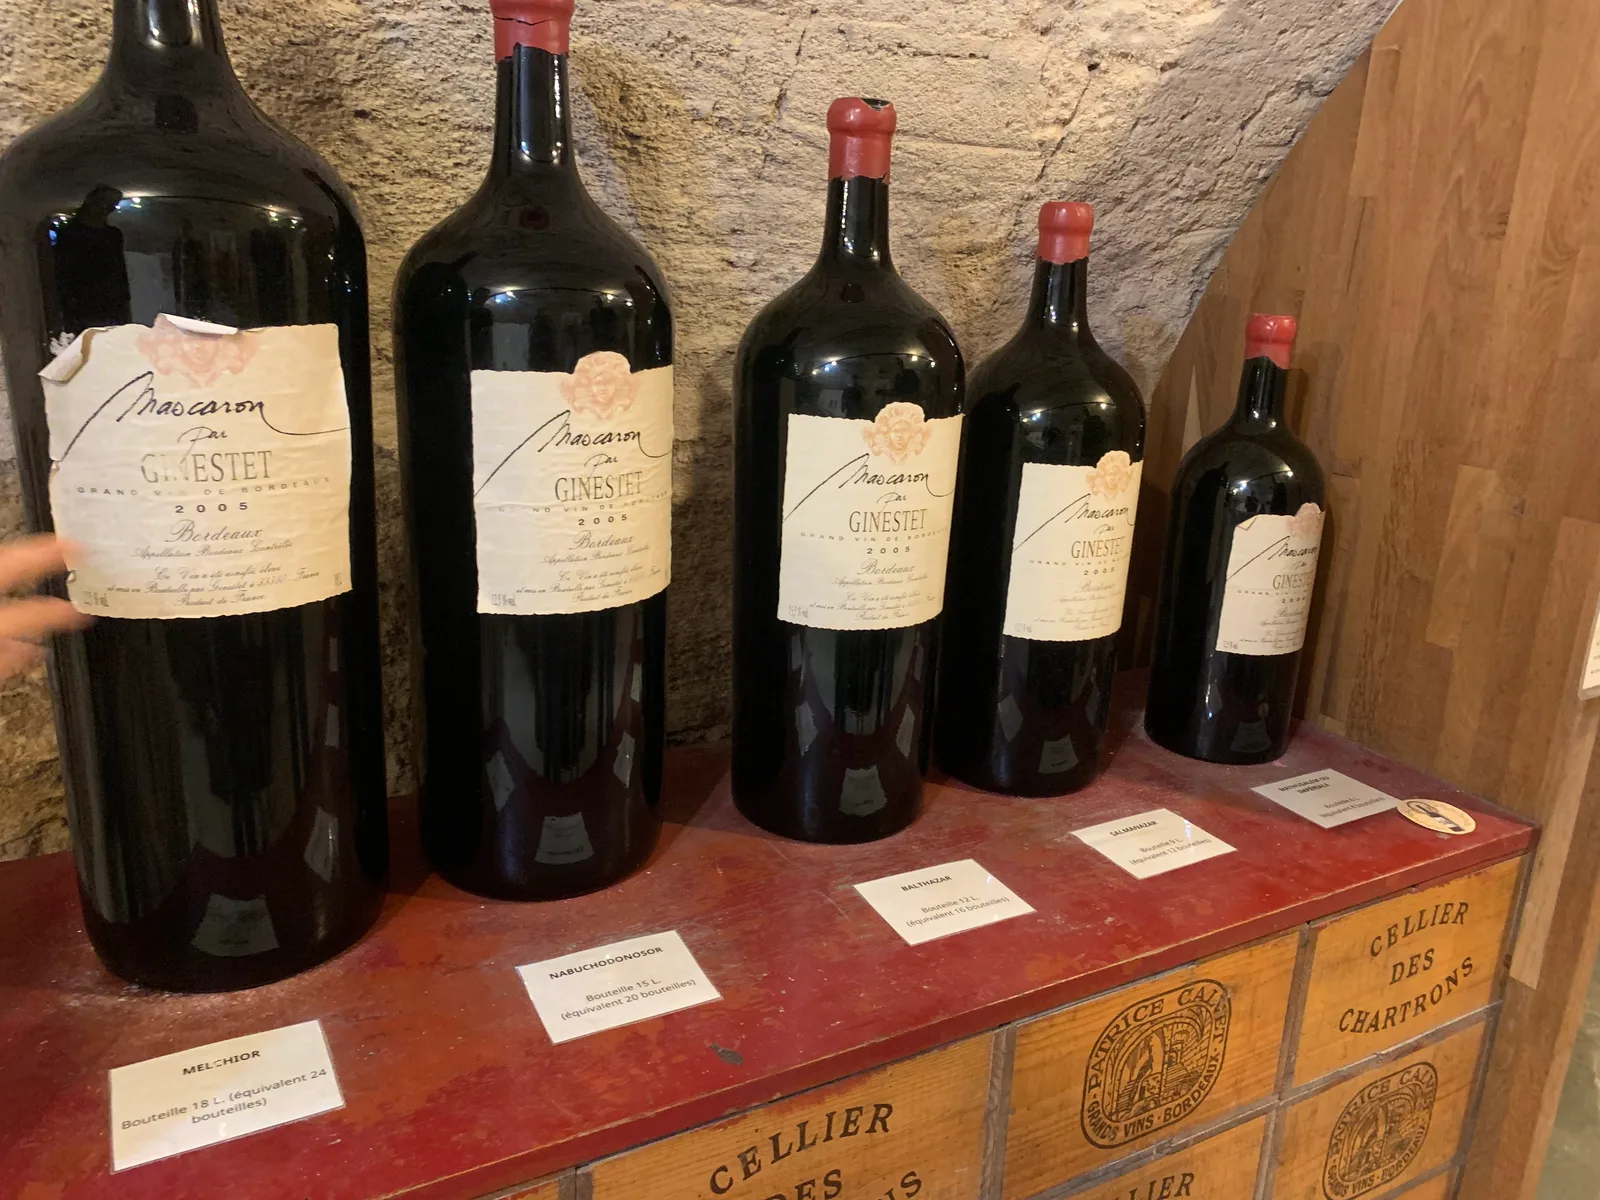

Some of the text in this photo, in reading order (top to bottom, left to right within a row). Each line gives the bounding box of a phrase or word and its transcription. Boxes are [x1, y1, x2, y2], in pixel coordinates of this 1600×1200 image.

[77, 485, 138, 497] GRAND
[204, 487, 226, 497] DE
[240, 476, 331, 493] BORDEAUX
[555, 470, 643, 502] GINESTET
[174, 501, 249, 514] 2005
[577, 513, 628, 527] 2005
[599, 503, 614, 511] DE
[849, 508, 927, 533] GINESTET
[165, 518, 263, 544] Bordeaux
[568, 529, 635, 551] Bordeaux
[800, 531, 845, 541] GRAND
[866, 545, 911, 555] 2005
[856, 557, 916, 575] Bordeaux
[1109, 820, 1158, 837] SALMANAZAR
[901, 875, 953, 892] BALTHAZAR
[906, 896, 1010, 928] (équivalent 16 bouteilles)
[921, 899, 959, 914] Bouteille
[959, 896, 970, 904] 12
[1370, 901, 1469, 958] CELLIER
[549, 946, 664, 980] NABUCHODONOSOR
[1389, 948, 1435, 985] DES
[560, 978, 698, 1021] (équivalent 20 bouteilles)
[585, 977, 662, 1003] Bouteille 15 L.
[1338, 956, 1473, 1033] CHARTRONS
[1088, 998, 1164, 1093] PATRICE
[182, 1049, 262, 1076] MELCHIOR
[121, 1067, 328, 1130] Bouteille 18 L. (équivalent 24
[191, 1097, 268, 1125] bouteilles)
[1087, 1053, 1221, 1142] GRANDS VINS BORDEAUX
[1330, 1079, 1391, 1158] PATRICE
[709, 1103, 894, 1195] CELLIER
[1352, 1174, 1376, 1194] VINS
[1381, 1124, 1426, 1180] BORDEAUX
[765, 1168, 843, 1200] ES
